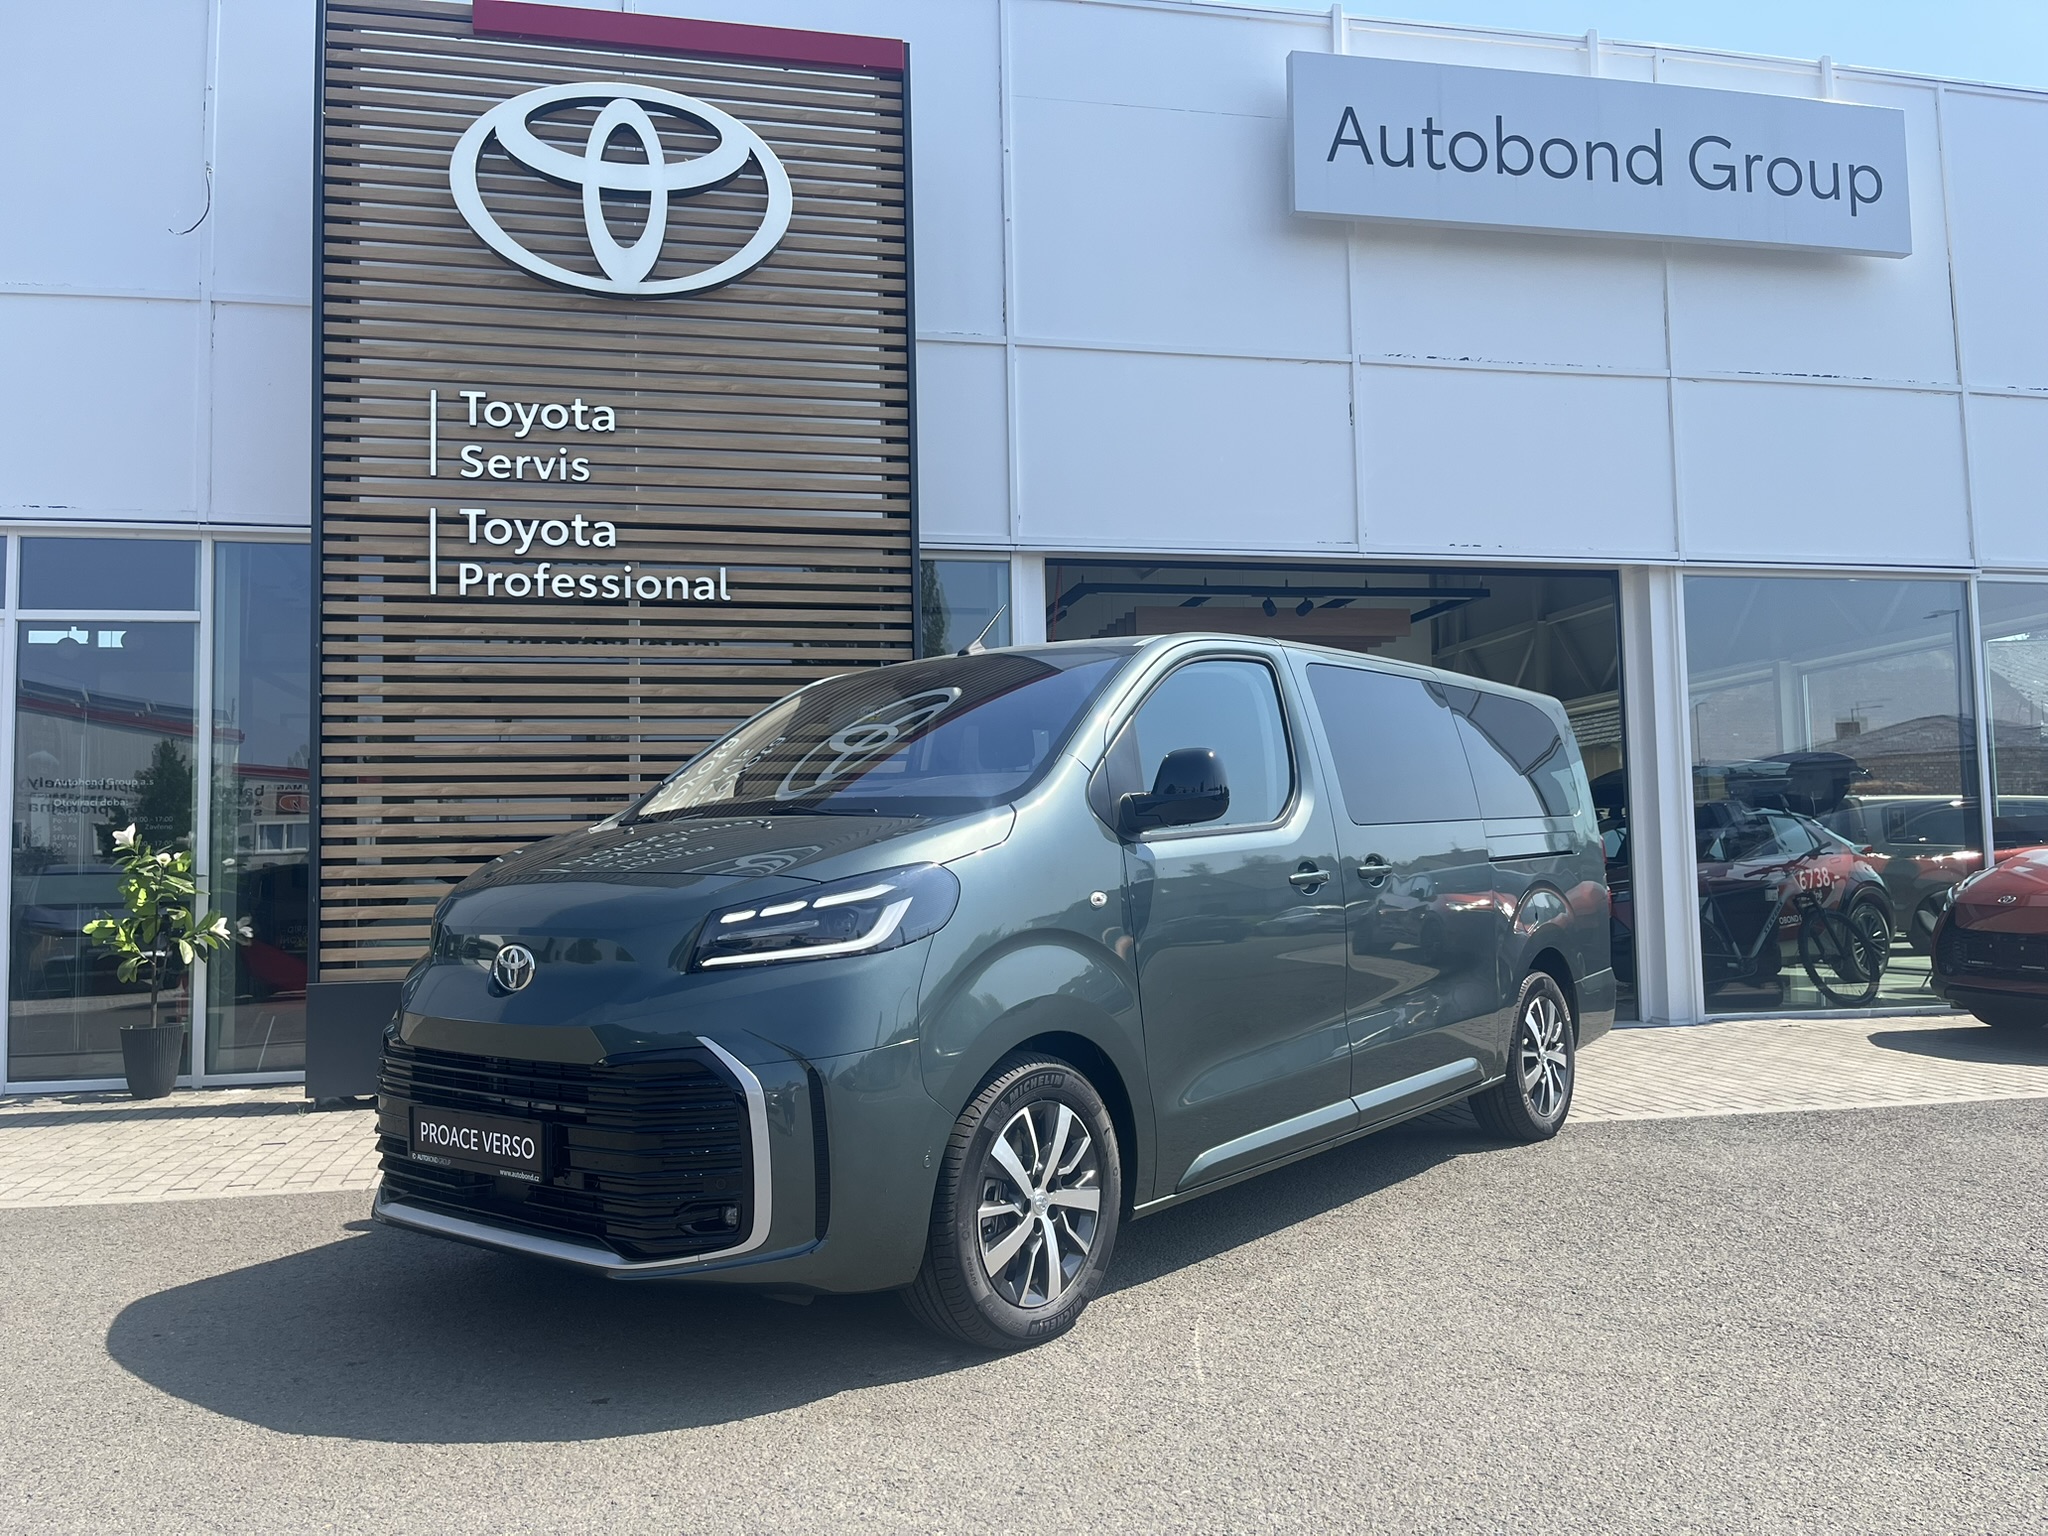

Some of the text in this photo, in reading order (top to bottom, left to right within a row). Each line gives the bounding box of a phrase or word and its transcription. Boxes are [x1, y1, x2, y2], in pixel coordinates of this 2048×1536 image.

[1326, 105, 1884, 217] Autobond Group
[459, 390, 616, 438] Toyota
[460, 444, 591, 482] Servis
[459, 508, 617, 556] Toyota
[459, 562, 731, 601] Professional
[106, 778, 139, 788] Group
[100, 798, 129, 807] doba:
[1799, 866, 1841, 890] 6738,-
[1010, 1074, 1064, 1102] MICHELIN
[420, 1121, 536, 1160] PROACE VERSO
[499, 1168, 540, 1182] www.autobond.cz
